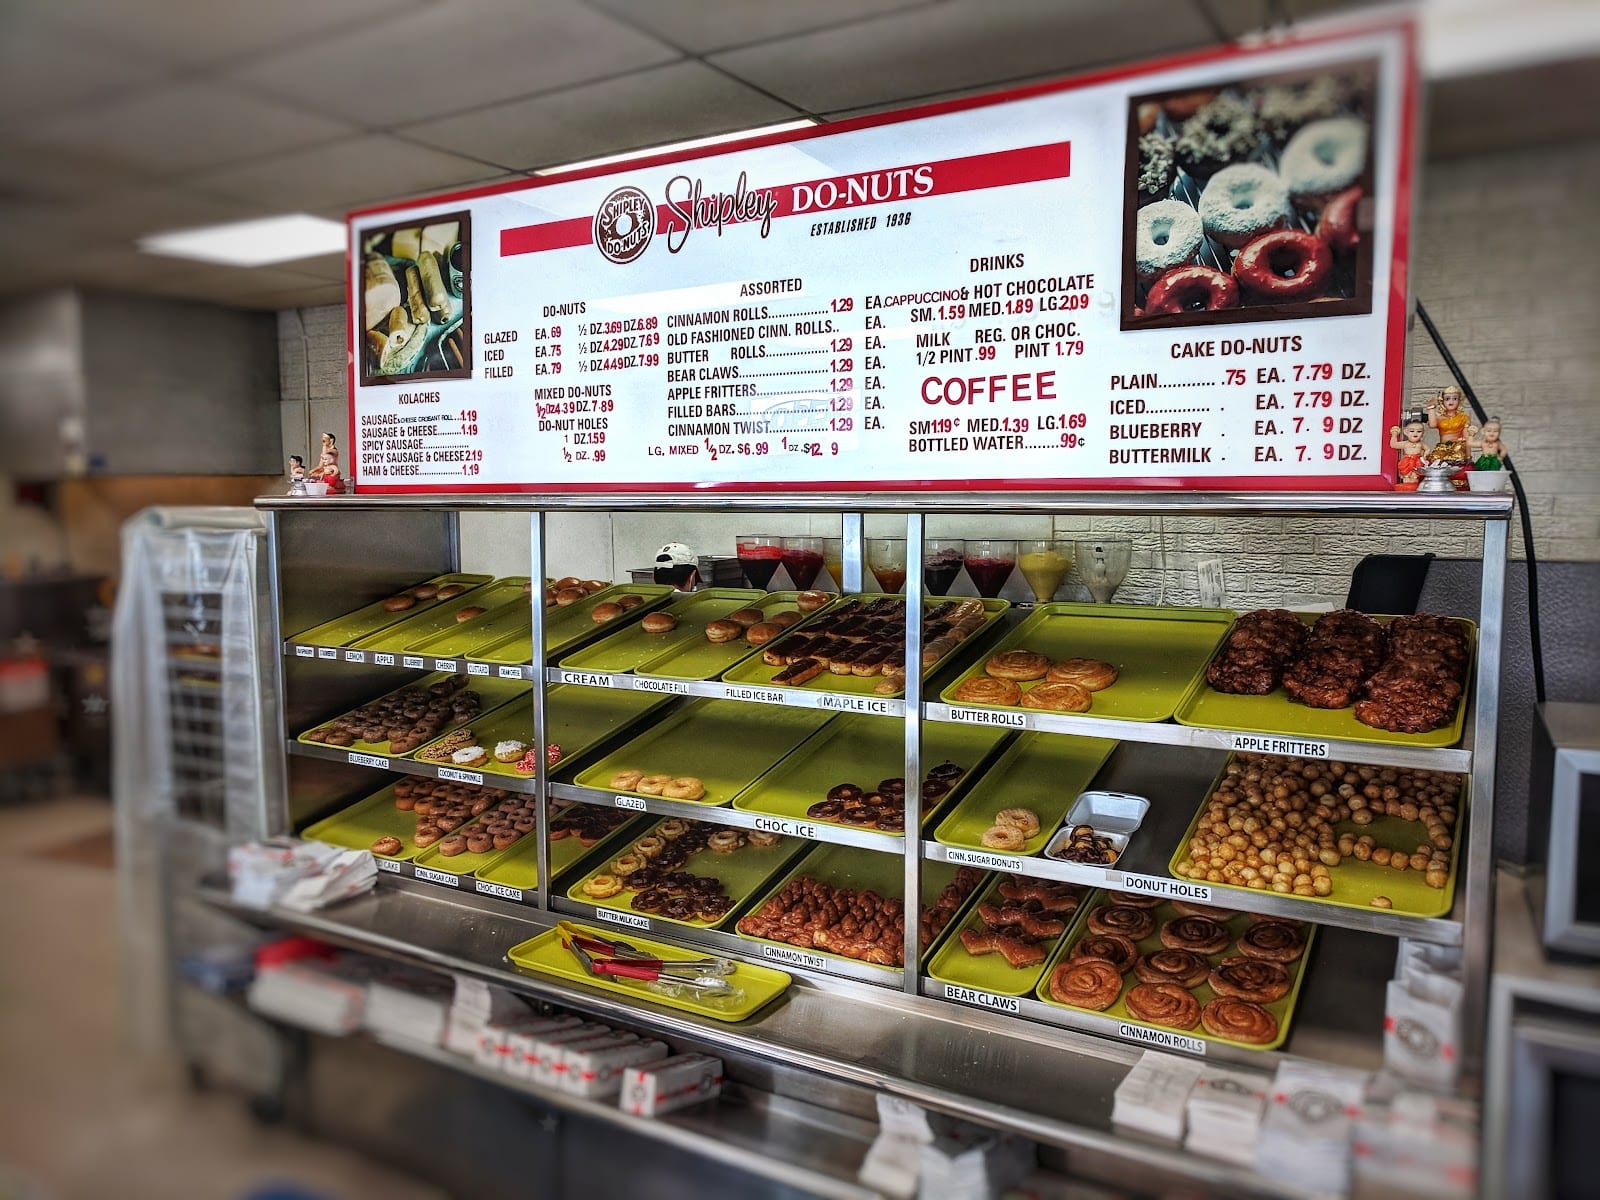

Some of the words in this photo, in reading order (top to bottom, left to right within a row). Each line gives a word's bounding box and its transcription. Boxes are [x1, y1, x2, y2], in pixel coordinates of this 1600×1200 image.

[602, 198, 645, 226] SHIPLEY
[665, 170, 779, 253] Shipley
[791, 166, 934, 213] DO-NUTS
[810, 216, 877, 237] ESTABLISHED
[970, 253, 1025, 273] DRINKS
[740, 277, 803, 297] ASSORTED
[885, 289, 960, 307] CAPPUCCINO
[974, 283, 1002, 299] HOT
[1006, 274, 1095, 296] CHOCOLATE
[543, 302, 586, 318] DO-NUTS
[667, 310, 730, 328] CINNAMON
[830, 297, 853, 313] 1.29
[865, 295, 884, 310] EA.
[938, 304, 966, 320] 1.59
[484, 330, 518, 345] GLAZED
[667, 332, 688, 346] OLD
[690, 326, 755, 345] FASHIONED
[758, 324, 792, 339] CINN.
[865, 315, 886, 330] EA.
[916, 332, 951, 348] MILK
[975, 328, 1006, 344] REG.
[1011, 326, 1030, 341] OR
[1035, 322, 1081, 339] CHOC.
[484, 349, 505, 362] ICED
[667, 349, 709, 365] BUTTER
[830, 337, 853, 353] 1.29
[865, 336, 886, 350] EA.
[916, 351, 936, 367] 1/2
[940, 348, 973, 364] PINT
[1015, 342, 1050, 359] PINT
[1055, 340, 1084, 356] 1.79
[1170, 340, 1215, 359] CAKE
[1220, 335, 1303, 356] DO-NUTS
[484, 365, 514, 379] FILLED
[667, 368, 696, 382] BEAR
[830, 358, 853, 373] 1.29
[865, 356, 886, 370] EA.
[1257, 367, 1285, 384] EA.
[1292, 363, 1333, 382] 7.79
[1341, 362, 1371, 380] DZ.
[534, 388, 565, 402] MIXED
[568, 384, 612, 399] DO-NUTS
[667, 386, 702, 401] APPLE
[830, 377, 853, 393] 1.29
[864, 376, 885, 390] EA.
[921, 370, 1057, 405] COFFEE
[398, 391, 440, 405] KOLACHES
[667, 404, 703, 419] FILLED
[830, 397, 853, 412] 1.29
[864, 395, 885, 410] EA.
[1255, 394, 1285, 411] EA.
[1293, 391, 1333, 409] 7.79
[1340, 390, 1370, 408] DZ.
[361, 414, 398, 426] SAUSAGE
[460, 409, 477, 422] 1.19
[538, 419, 574, 433] DO-NUT
[577, 417, 608, 431] HOLES
[668, 422, 730, 437] CINNAMON
[829, 417, 853, 432] 1.29
[864, 416, 885, 430] EA.
[361, 427, 398, 439] SAUSAGE
[400, 426, 406, 437] &
[461, 423, 478, 436] 1.19
[1109, 422, 1202, 440] BLUEBERRY
[1254, 419, 1284, 436] EA.
[1339, 417, 1363, 434] DZ
[362, 439, 384, 451] SPICY
[669, 445, 699, 456] MIXED
[737, 441, 769, 456] $6.99
[909, 436, 969, 452] BOTTLED
[362, 452, 384, 464] SPICY
[386, 451, 424, 463] SAUSAGE
[426, 451, 432, 462] &
[1109, 447, 1212, 464] BUTTERMILK
[1254, 445, 1283, 462] EA.
[1338, 444, 1367, 461] DZ.
[362, 465, 381, 476] HAM
[383, 465, 388, 476] &
[462, 463, 480, 476] 1.19
[346, 650, 363, 662] LEMON
[376, 654, 393, 665] APPLE
[436, 660, 456, 672] CHERRY
[468, 663, 488, 675] CUSTARD
[564, 672, 610, 686] CREAM
[634, 678, 673, 693] CHOCOLATE
[674, 682, 688, 694] FILL
[726, 688, 752, 700] FILLED
[753, 690, 766, 701] ICE
[767, 691, 784, 703] BAR
[822, 695, 865, 712] MAPLE
[867, 700, 888, 713] ICE
[951, 709, 990, 724] BUTTER
[991, 713, 1024, 726] ROLLS
[1234, 737, 1271, 753] APPLE
[1272, 739, 1326, 757] FRITTERS
[349, 753, 375, 766] BLUEBERRY
[375, 757, 388, 768] CAKE
[439, 769, 457, 779] COCONUT
[462, 773, 481, 783] SPRINKLE
[616, 797, 645, 810] GLAZED
[755, 818, 792, 834] CHOC.
[796, 825, 815, 837] ICE
[384, 861, 399, 871] CAKE
[948, 851, 967, 862] CINN.
[967, 854, 989, 866] SUGAR
[990, 857, 1020, 870] DONUTS
[426, 871, 444, 882] SUGAR
[444, 874, 458, 885] CAKE
[477, 882, 495, 894] CHOC.
[495, 886, 505, 896] ICE
[505, 888, 521, 899] CAKE
[1126, 876, 1169, 894] DONUT
[1171, 884, 1209, 900] HOLES
[598, 910, 619, 922] BUTTER
[619, 913, 633, 924] MILK
[633, 916, 648, 927] CAKE
[765, 946, 803, 964] CINNAMON
[803, 955, 824, 968] TWIST
[946, 986, 976, 1003] BEAR
[977, 993, 1018, 1012] CLAWS
[1120, 1024, 1171, 1045] CINNAMON
[1173, 1036, 1203, 1052] ROLLS
